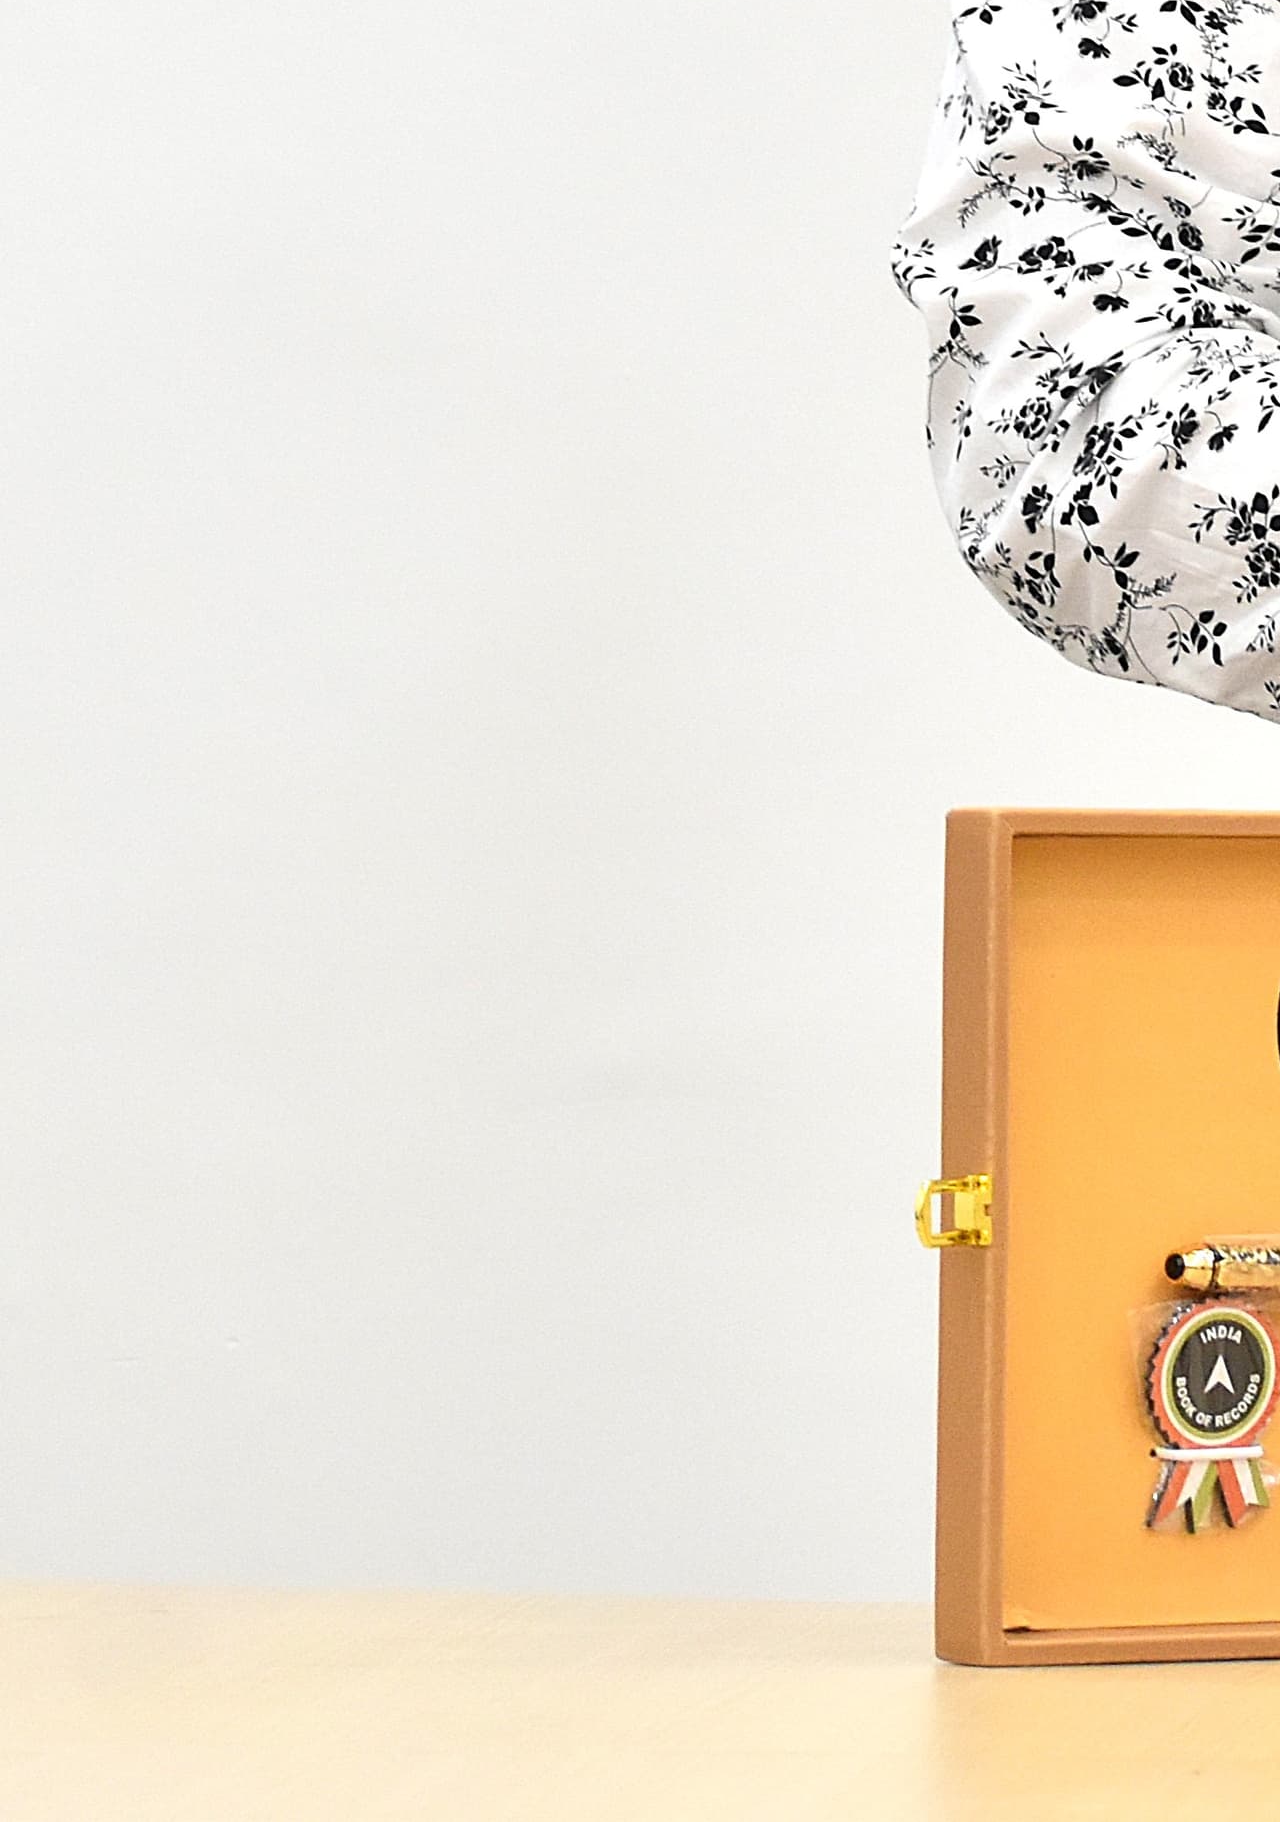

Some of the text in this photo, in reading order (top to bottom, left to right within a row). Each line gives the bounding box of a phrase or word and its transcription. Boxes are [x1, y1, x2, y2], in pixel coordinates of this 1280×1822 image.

[1200, 1325, 1242, 1344] INDIA
[1176, 1373, 1260, 1427] BOOK OF RECORDS
